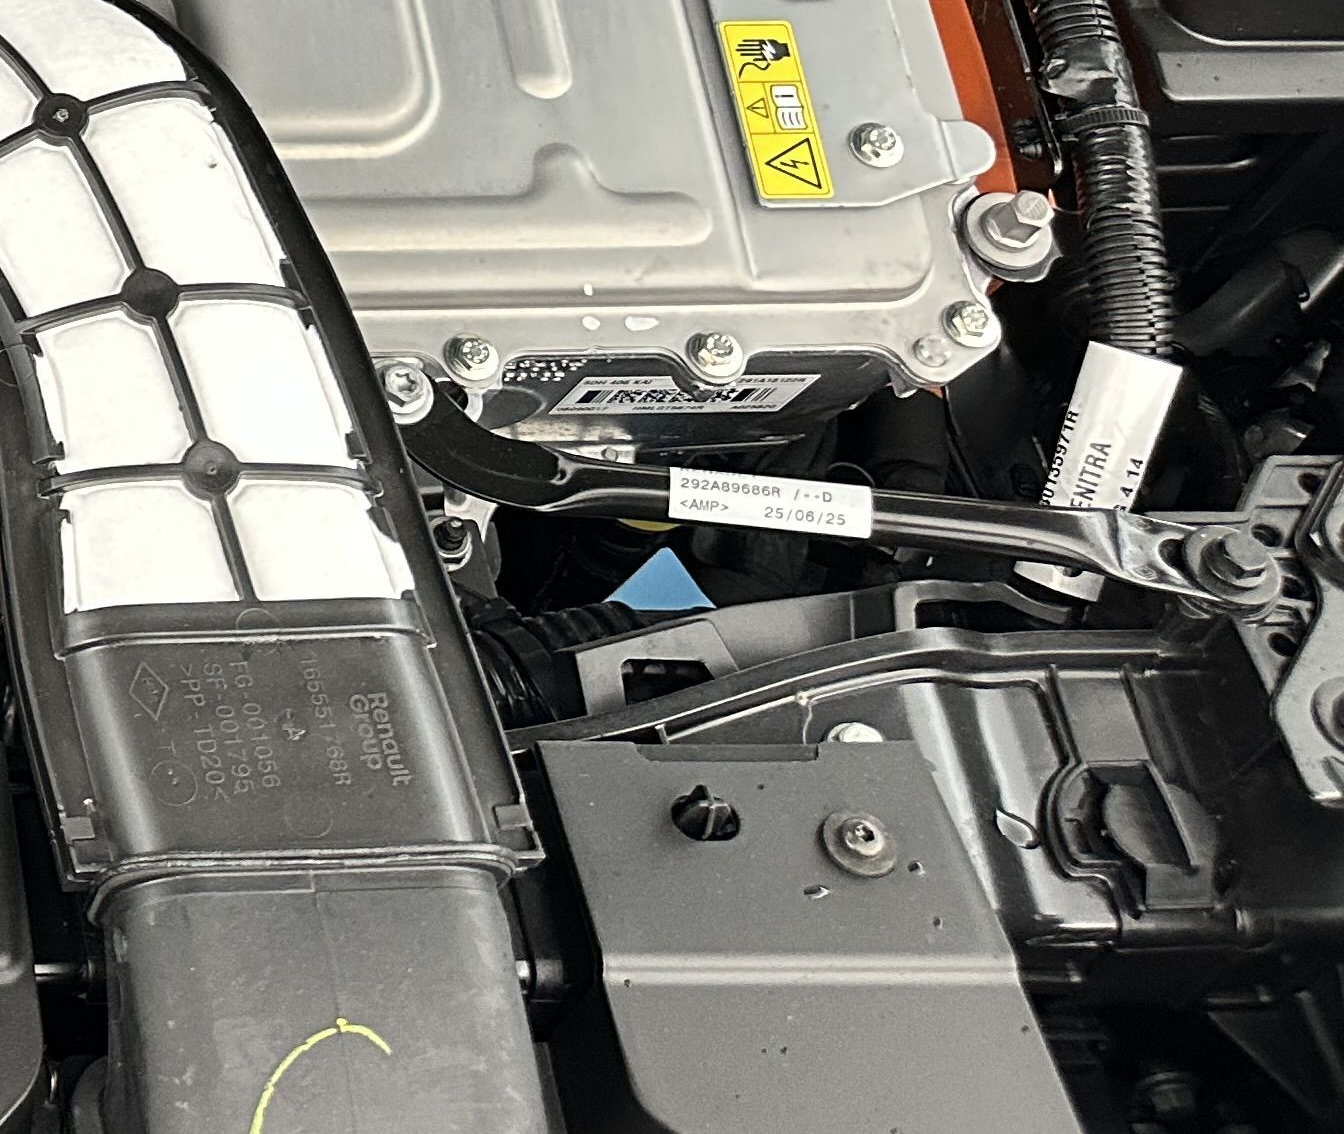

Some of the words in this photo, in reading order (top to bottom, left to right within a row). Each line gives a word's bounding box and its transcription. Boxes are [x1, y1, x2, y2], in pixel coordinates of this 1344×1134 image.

[679, 498, 729, 512] <AMP>
[764, 506, 847, 526] 25/06/25
[228, 660, 281, 789] FG-001056
[349, 693, 384, 771] Group
[367, 691, 413, 787] Renault
